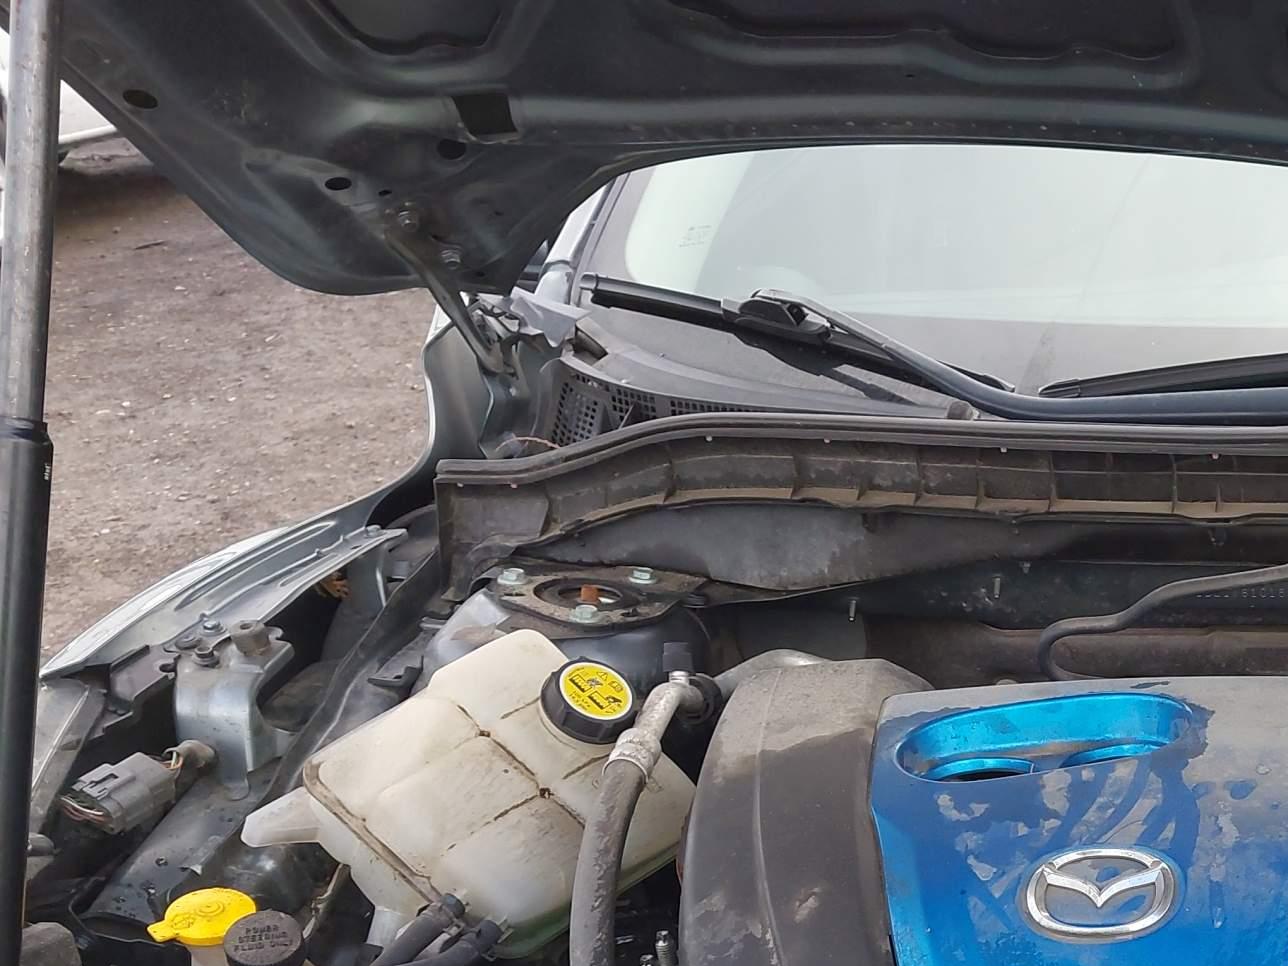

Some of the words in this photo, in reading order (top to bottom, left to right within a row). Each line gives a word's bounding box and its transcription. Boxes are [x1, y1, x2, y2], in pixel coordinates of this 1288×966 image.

[245, 924, 280, 935] POWER
[238, 931, 289, 944] STEERING
[270, 938, 294, 948] ONLY
[233, 942, 265, 953] FLUID
